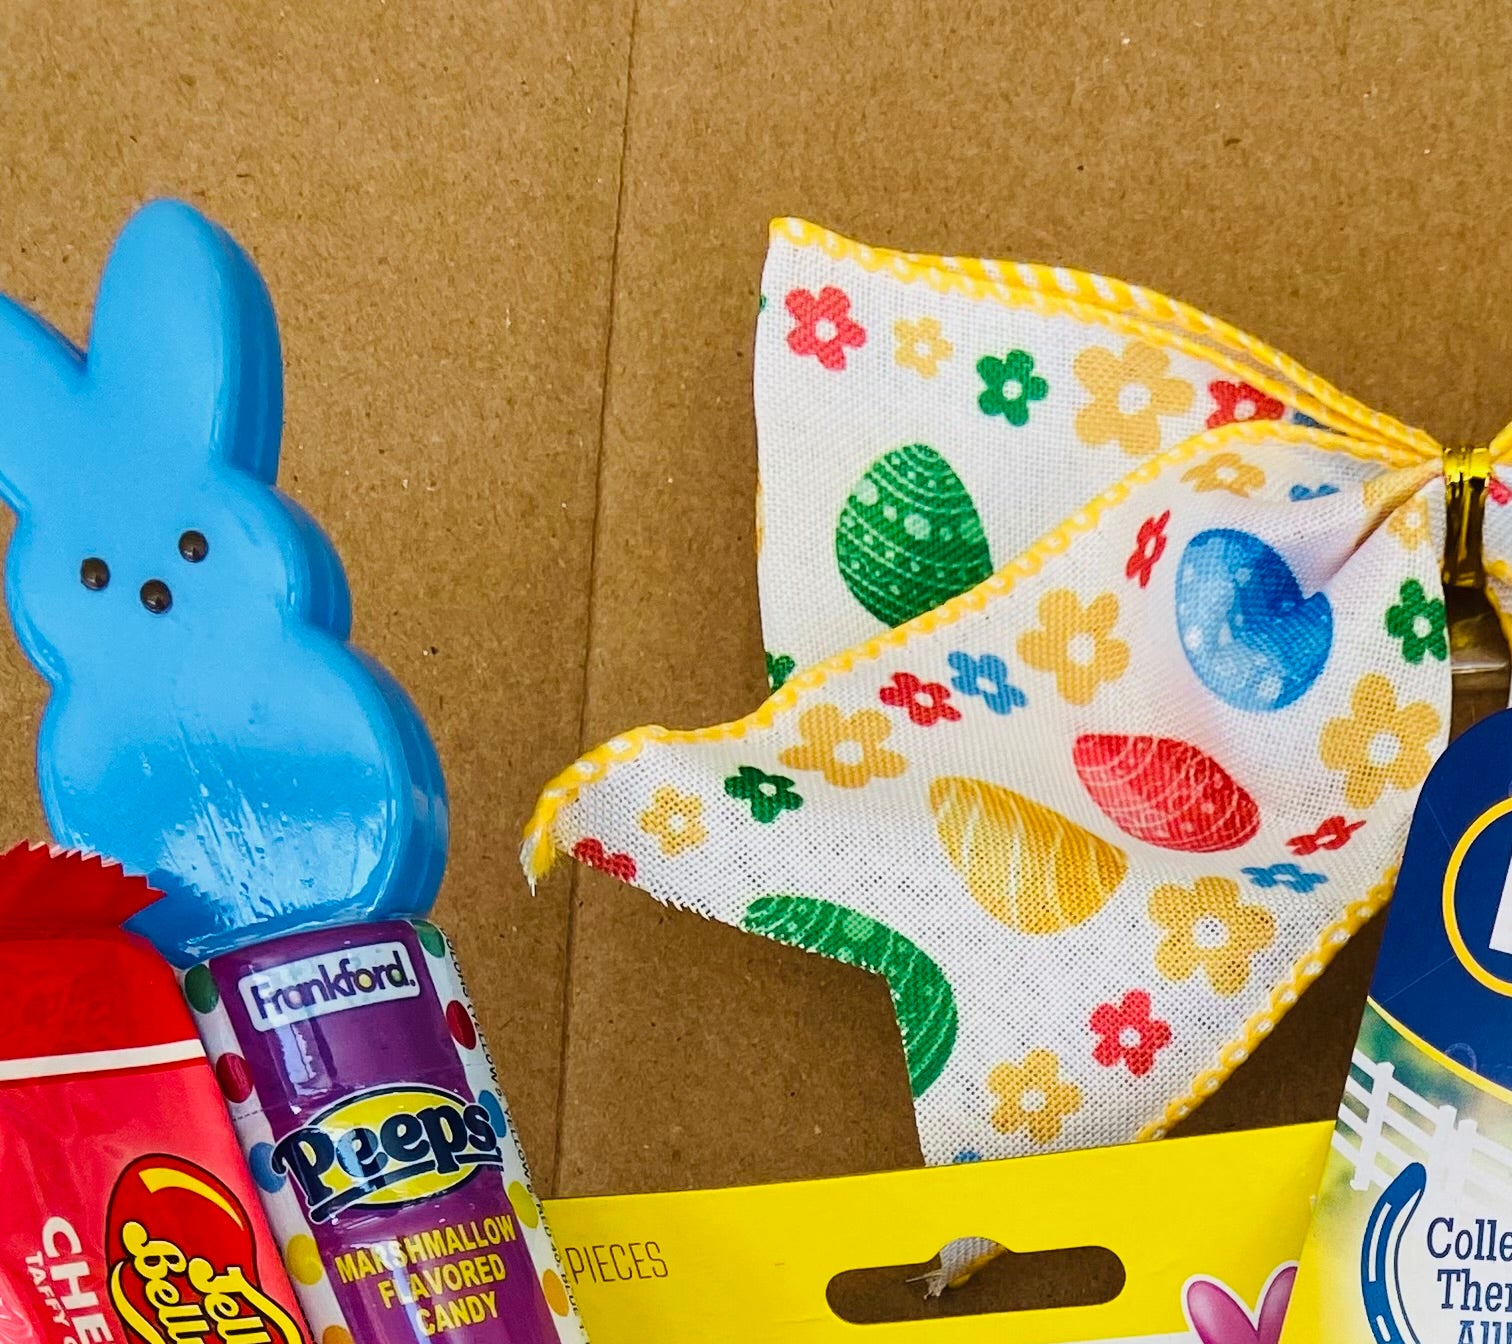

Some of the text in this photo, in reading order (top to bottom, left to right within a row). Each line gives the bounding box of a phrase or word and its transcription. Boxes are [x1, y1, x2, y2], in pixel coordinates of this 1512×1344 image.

[272, 1102, 501, 1210] Peeps
[335, 1215, 517, 1284] MARSHMALLOW
[565, 1241, 669, 1285] PIECES
[25, 1251, 70, 1327] TAFFY
[378, 1256, 507, 1309] FLAVORED
[417, 1291, 499, 1337] CANDY
